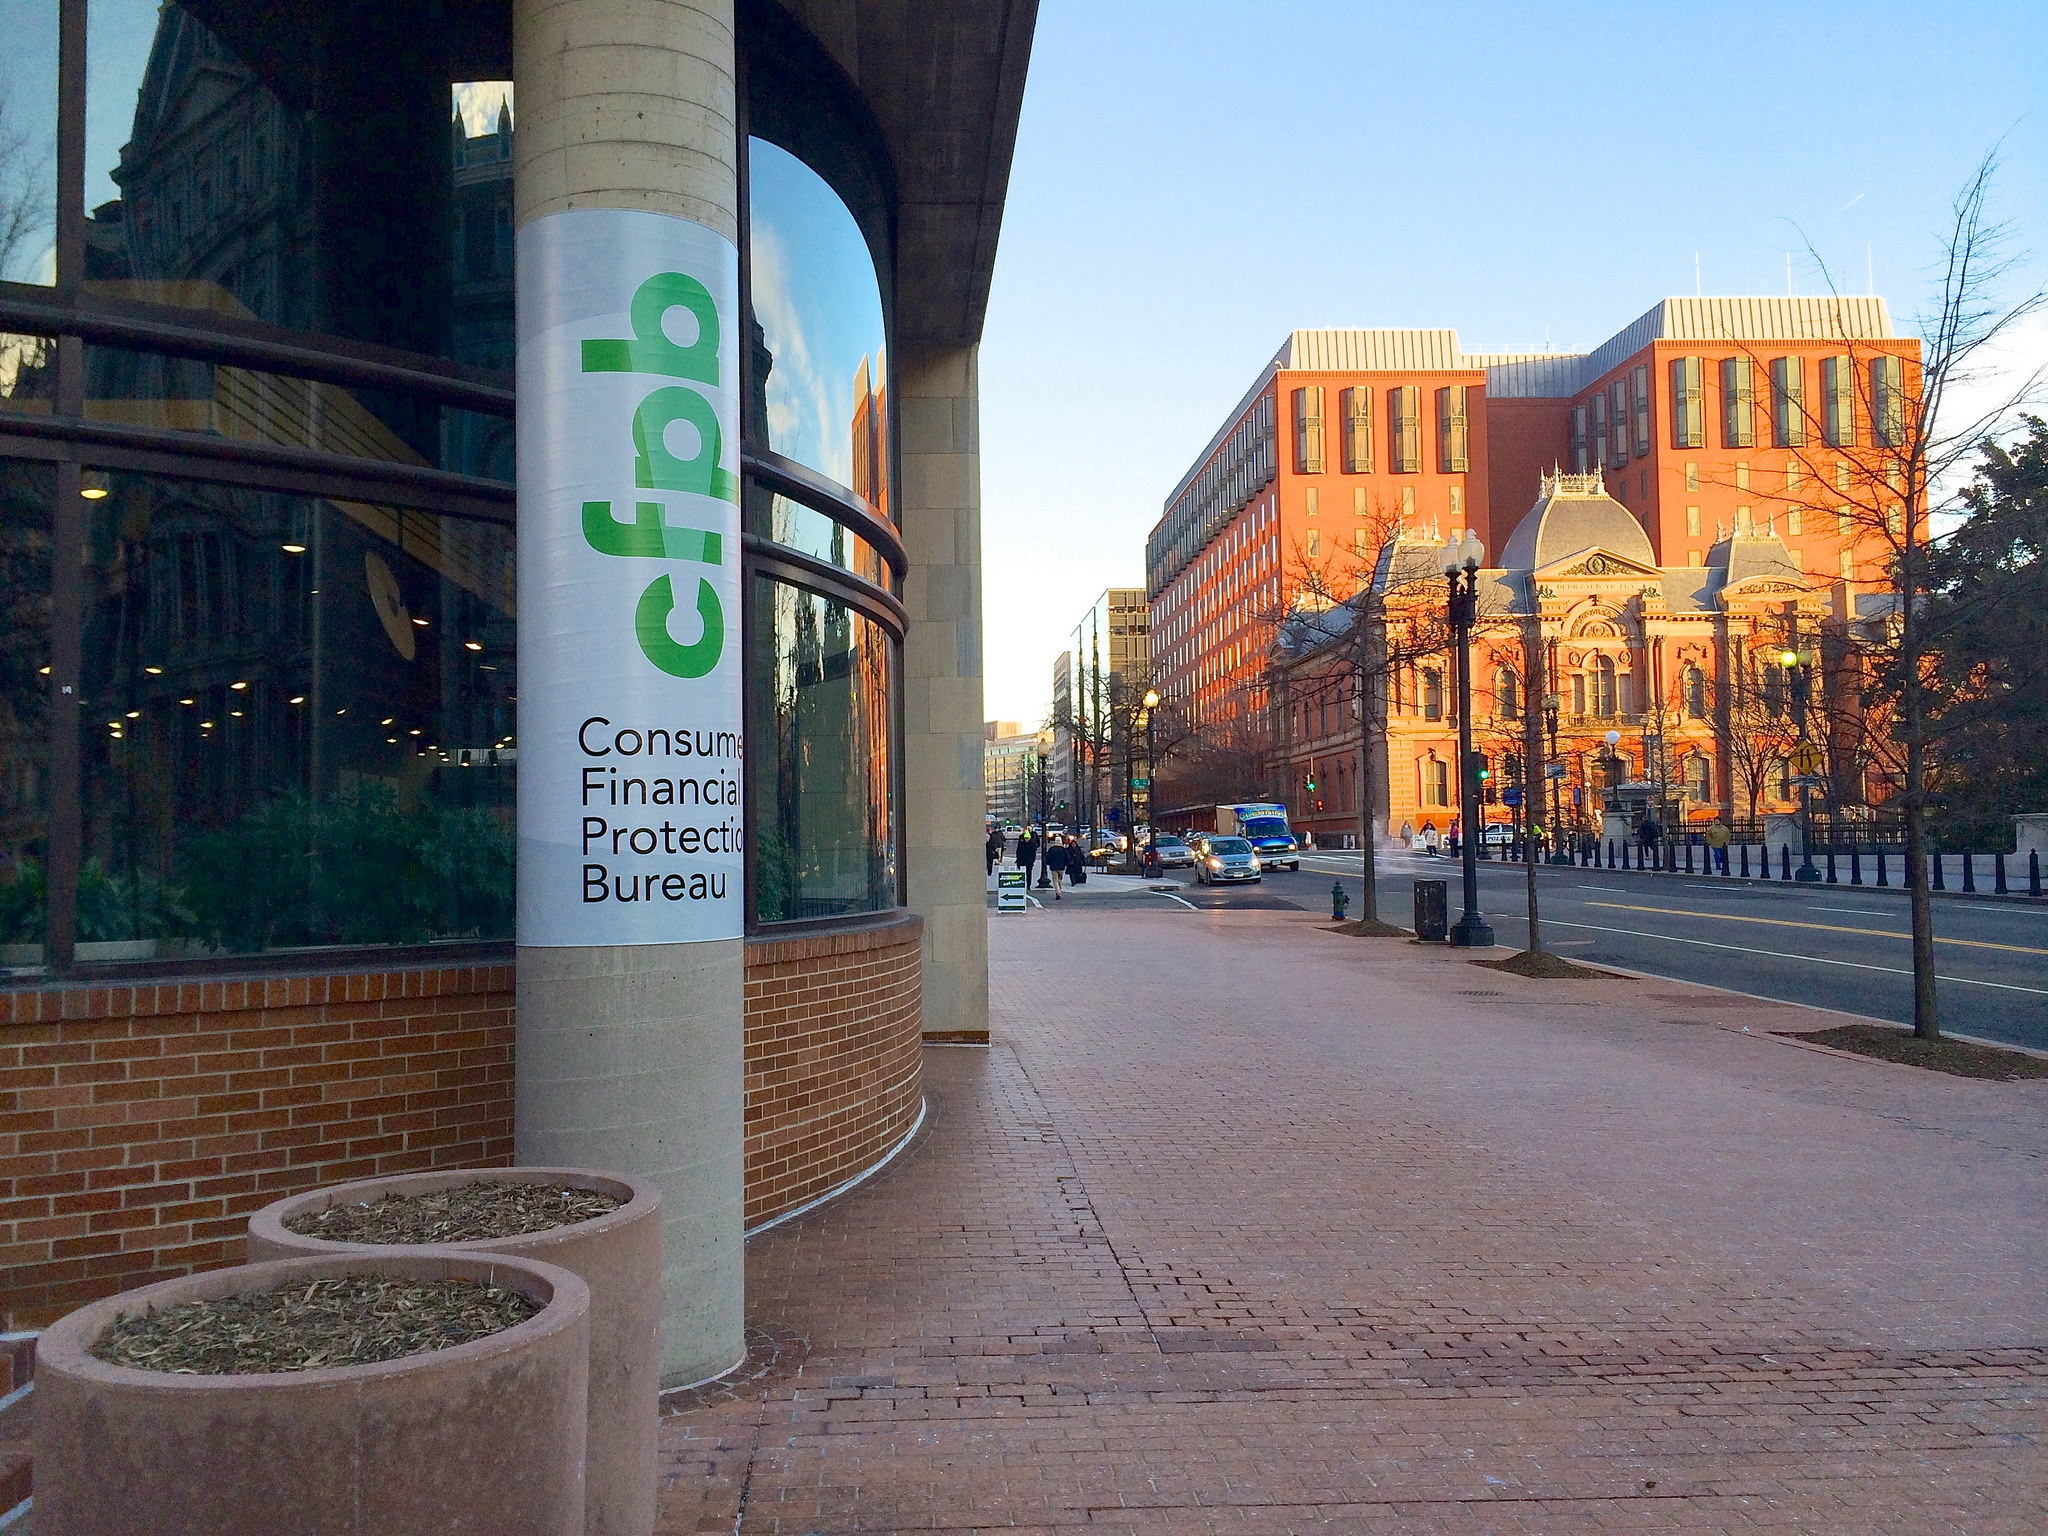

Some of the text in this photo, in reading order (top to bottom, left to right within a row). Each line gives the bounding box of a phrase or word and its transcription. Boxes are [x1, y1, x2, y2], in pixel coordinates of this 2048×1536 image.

[581, 271, 740, 680] cfpb
[582, 766, 742, 806] Financial
[582, 863, 727, 903] Bureau
